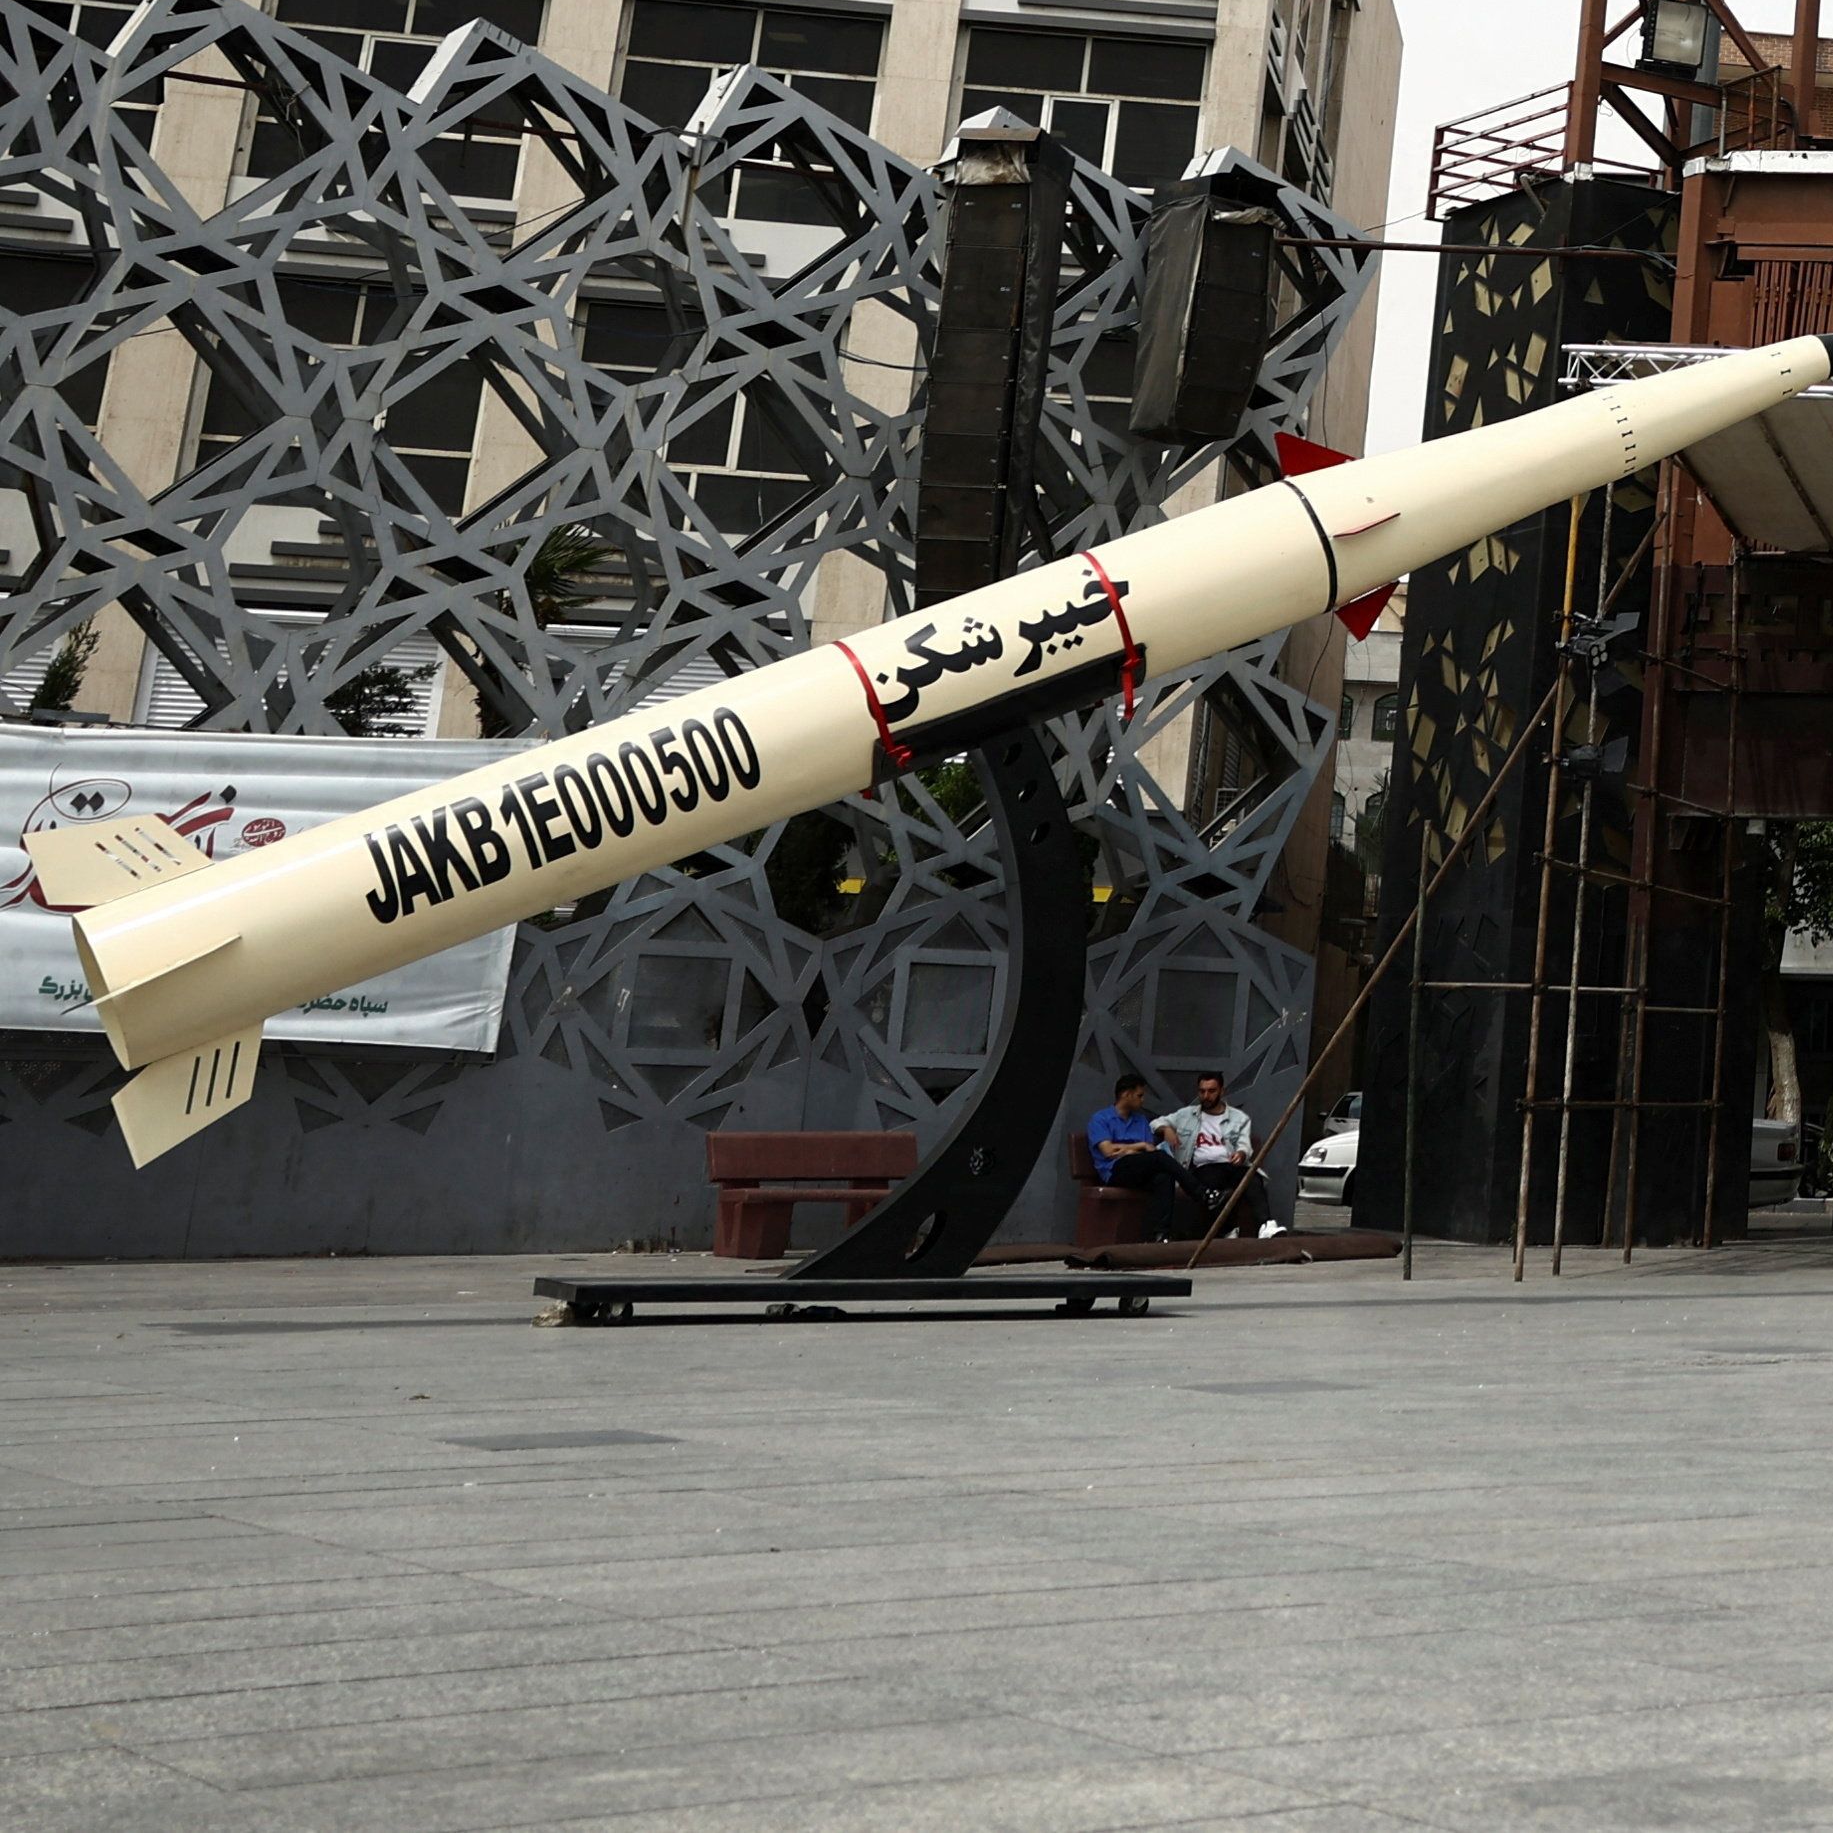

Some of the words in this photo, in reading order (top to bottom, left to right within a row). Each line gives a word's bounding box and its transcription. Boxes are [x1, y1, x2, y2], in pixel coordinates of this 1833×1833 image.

[866, 616, 1004, 725] شکن
[1013, 568, 1130, 678] خیبر
[364, 706, 761, 925] JAKB1E000500
[349, 995, 389, 1018] سپاه
